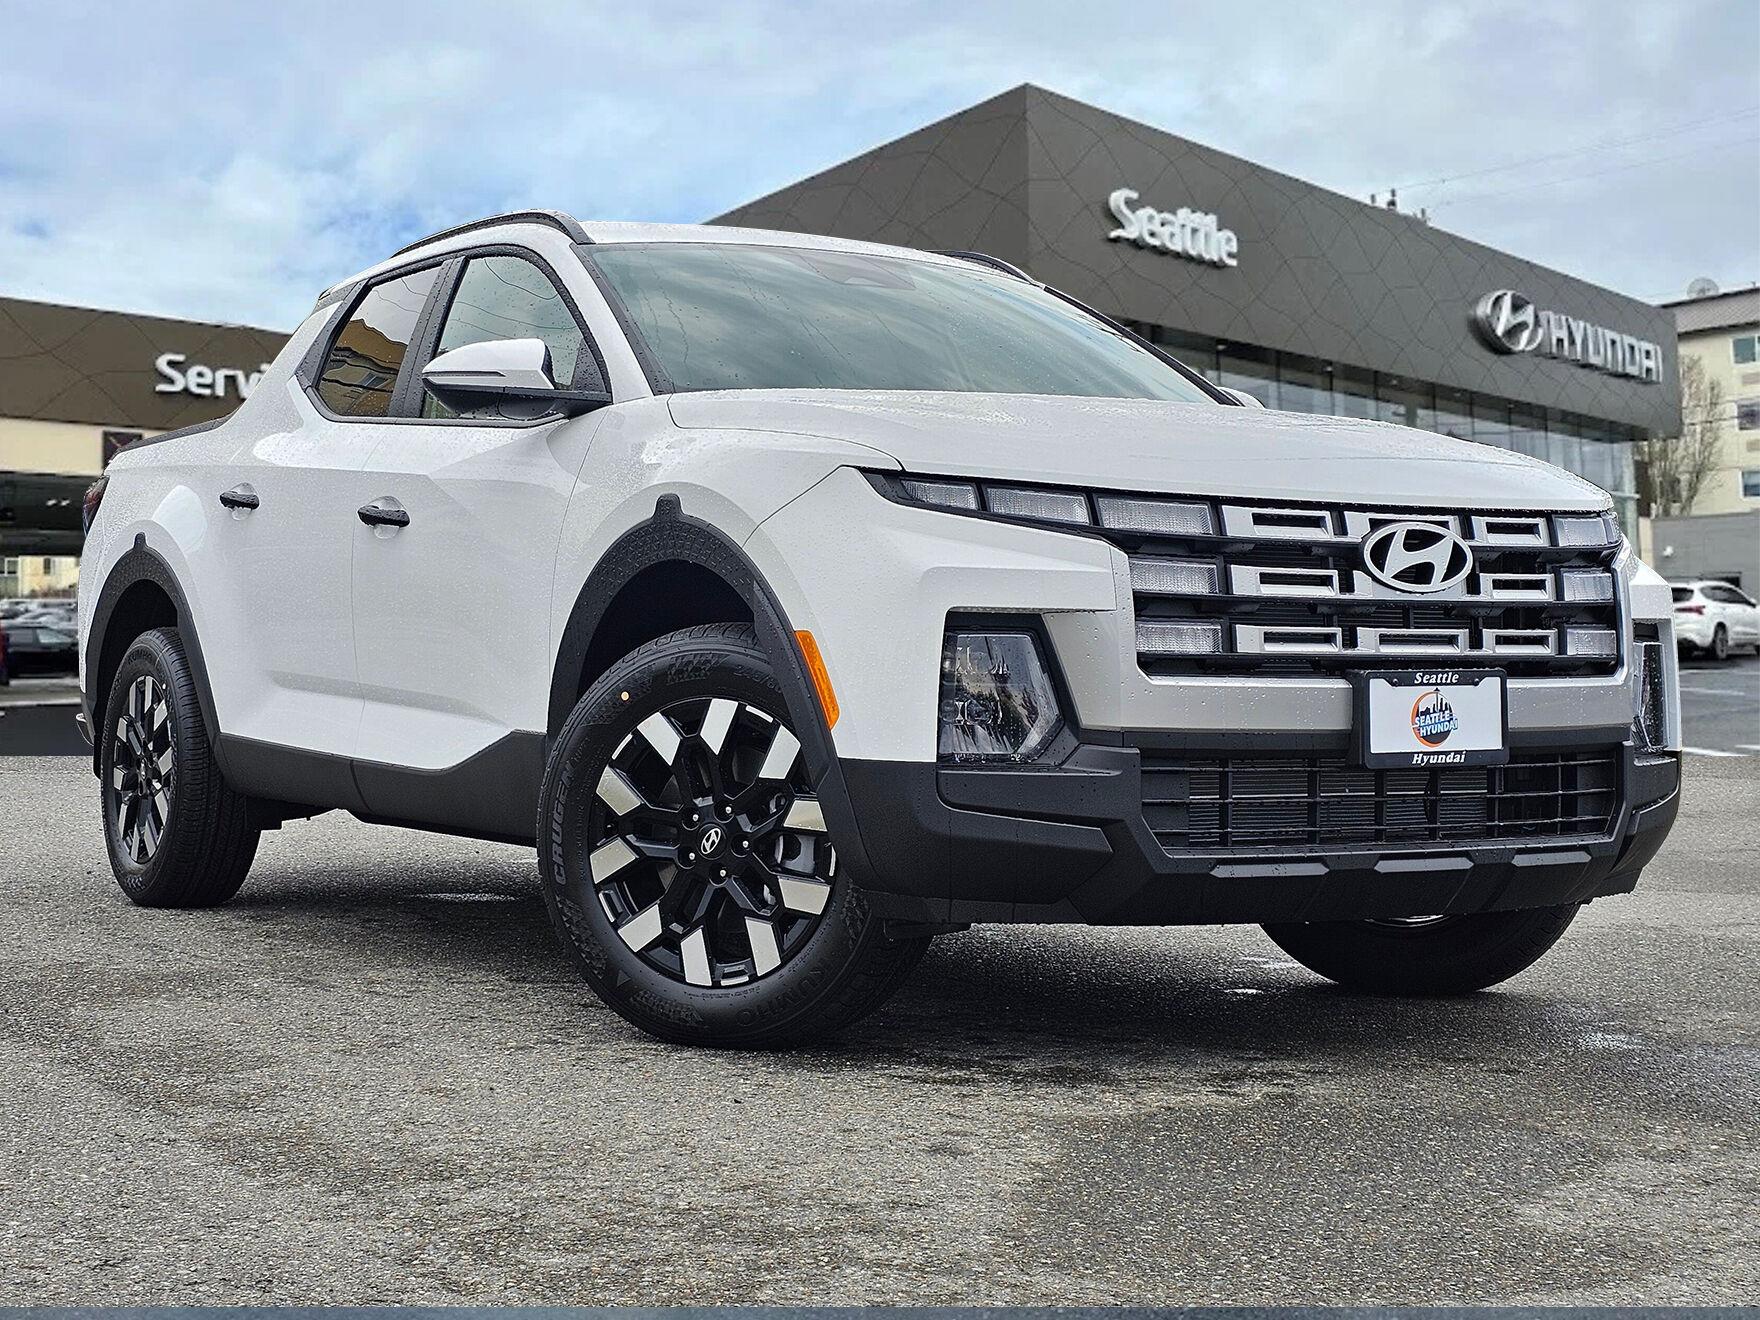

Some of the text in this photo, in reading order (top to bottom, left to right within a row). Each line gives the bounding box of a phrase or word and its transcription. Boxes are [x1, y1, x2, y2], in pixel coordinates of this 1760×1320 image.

[1108, 188, 1238, 266] Seattle
[1538, 311, 1663, 383] HYUNDAI
[1414, 672, 1460, 684] Seattle
[1414, 711, 1450, 727] SEATTLE
[1419, 719, 1459, 737] HYUNDAI
[1412, 751, 1466, 766] Hyundai
[551, 759, 575, 885] CRUGEN
